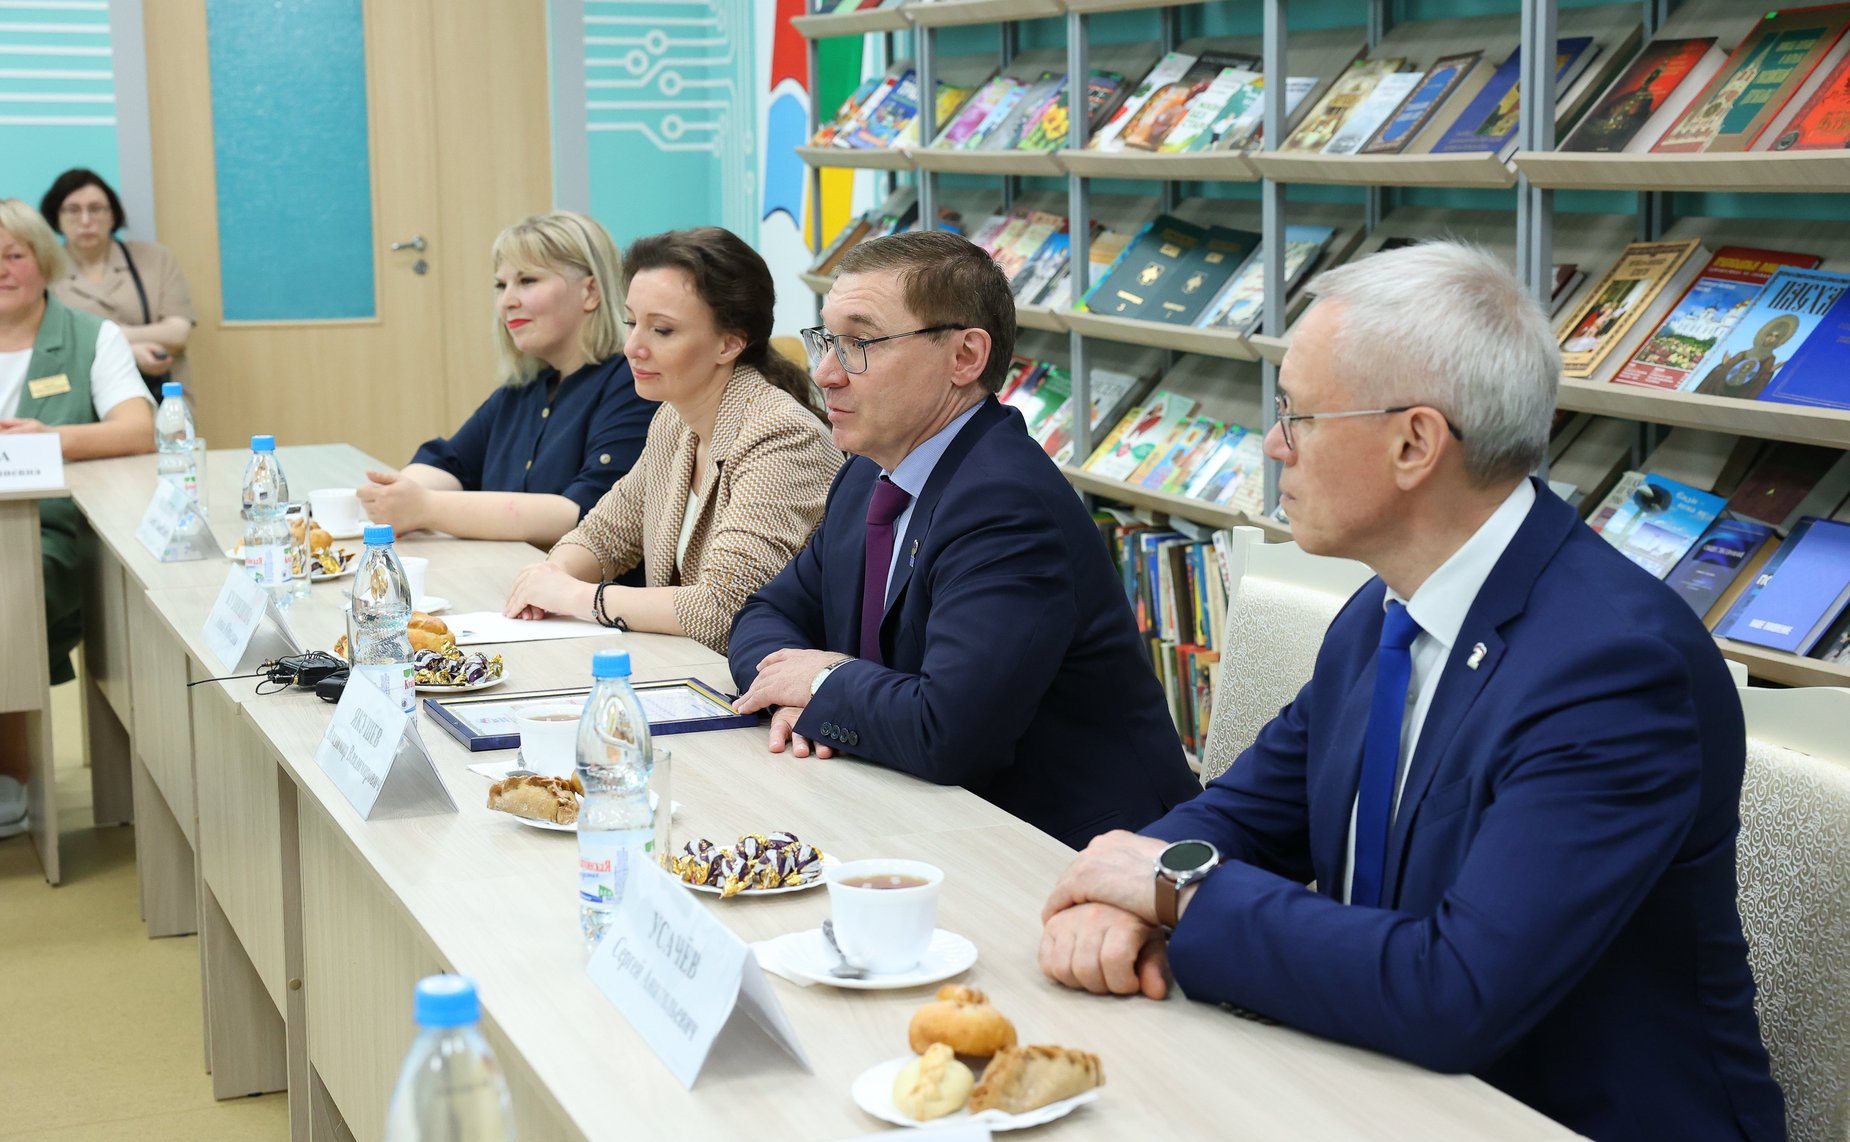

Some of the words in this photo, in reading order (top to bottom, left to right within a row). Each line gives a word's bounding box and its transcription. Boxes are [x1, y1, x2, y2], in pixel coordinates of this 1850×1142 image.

[1768, 280, 1845, 316] ПАСХА
[350, 707, 384, 748] ЯКУШЕВ
[611, 936, 645, 985] Сергей
[647, 910, 702, 981] УСАЧЁВ
